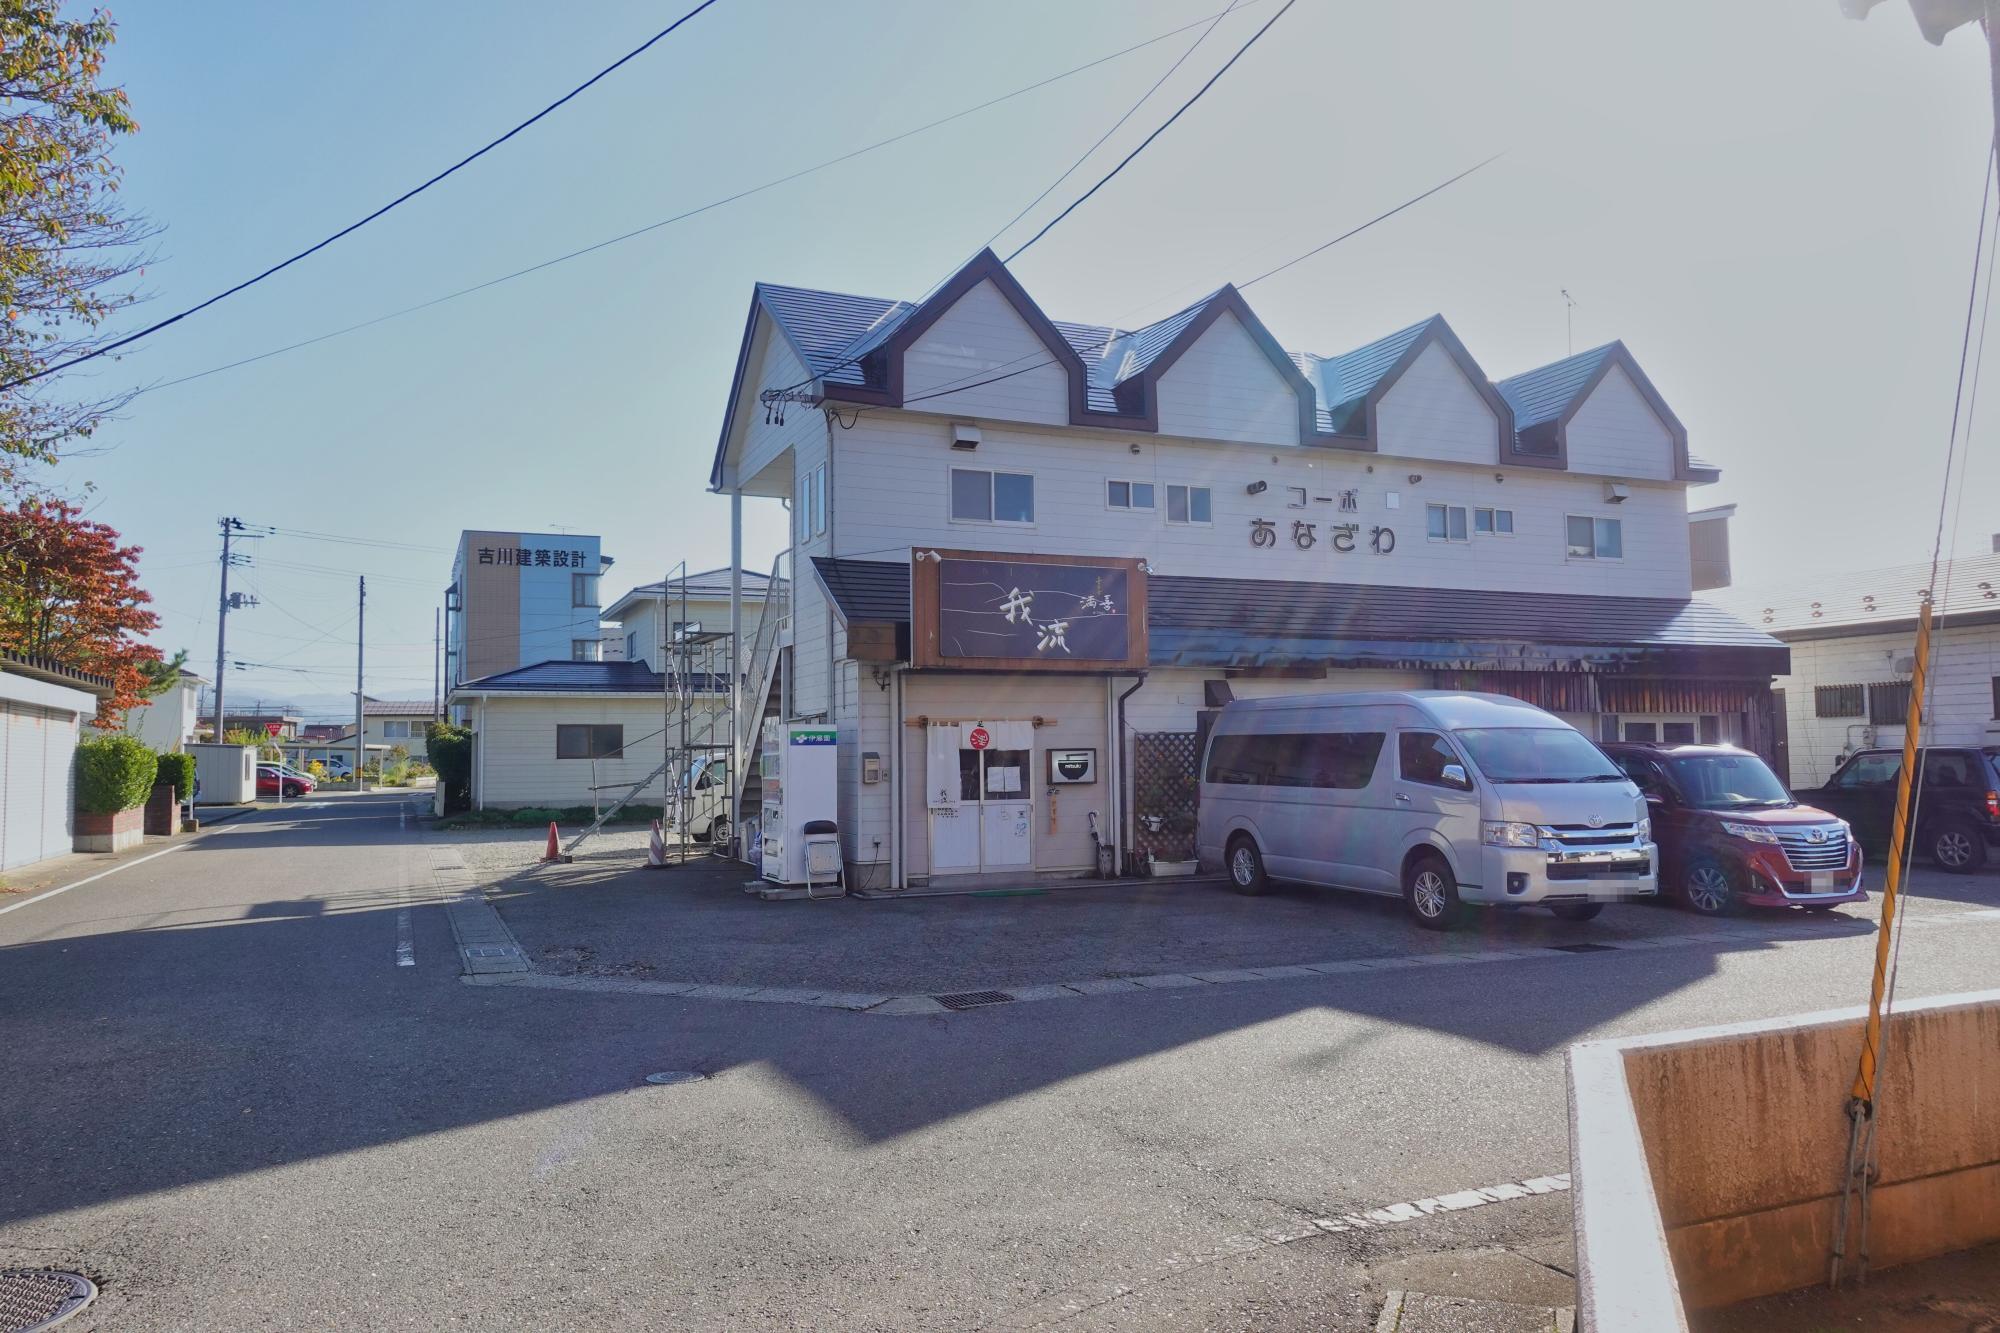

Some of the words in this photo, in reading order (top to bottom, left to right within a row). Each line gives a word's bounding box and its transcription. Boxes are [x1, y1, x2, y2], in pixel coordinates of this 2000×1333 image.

[1287, 486, 1359, 513] コーポ
[1250, 518, 1396, 554] あなざわ
[478, 547, 587, 568] 吉川建築設計
[999, 586, 1071, 654] 我流
